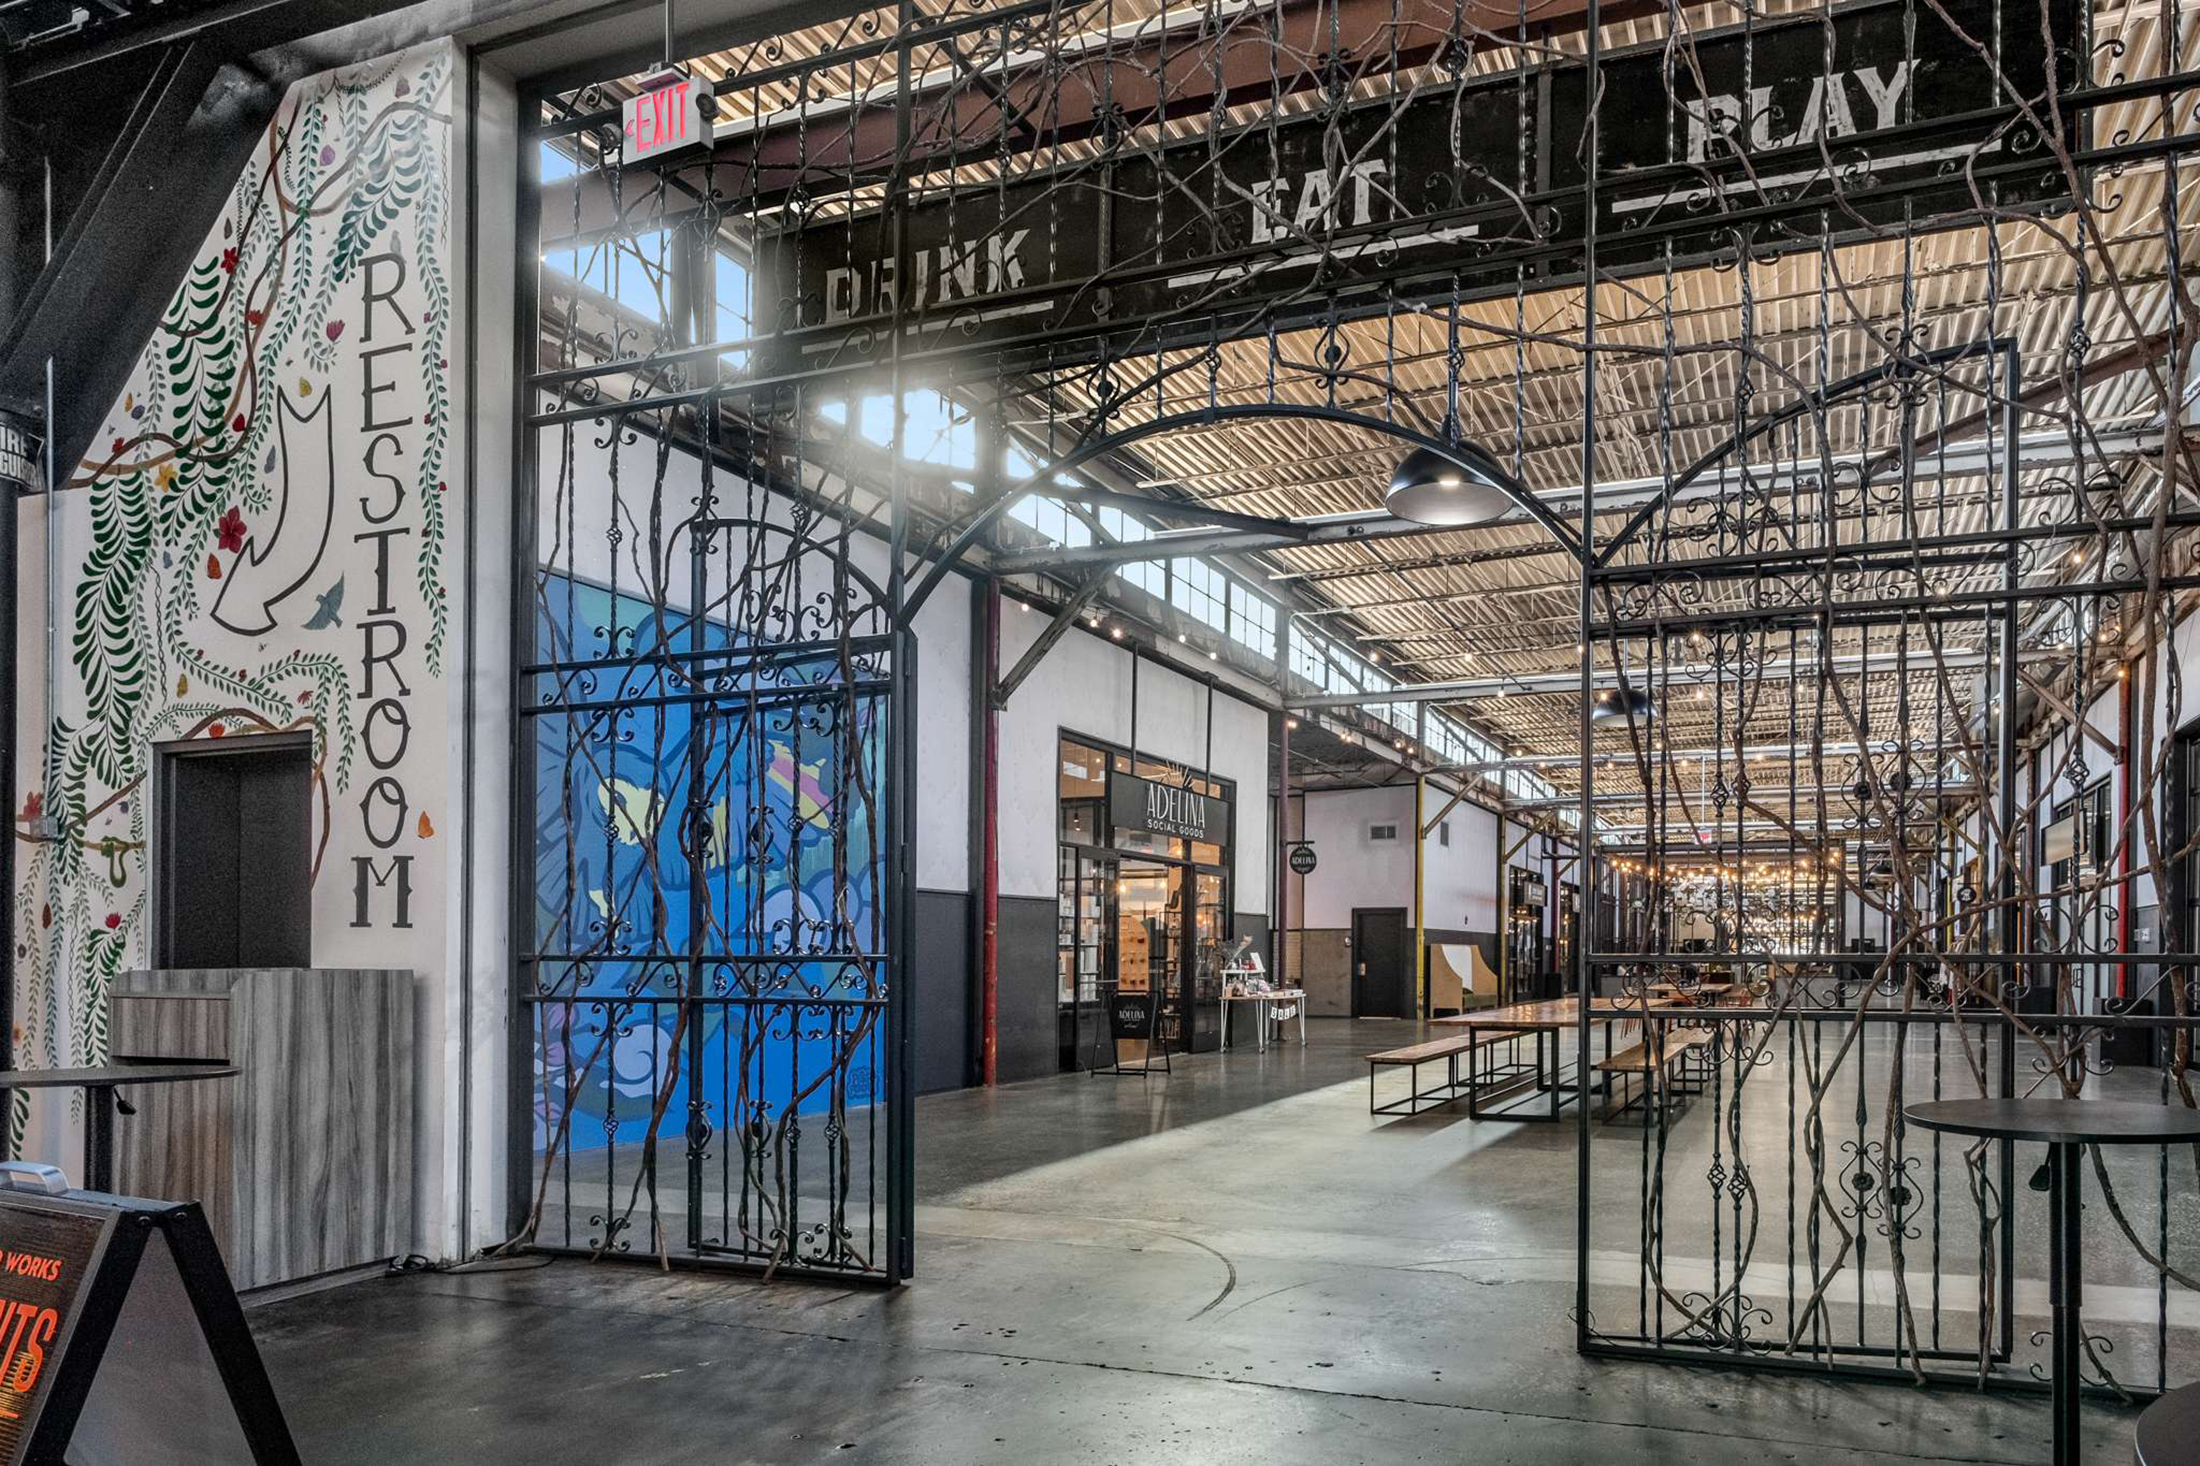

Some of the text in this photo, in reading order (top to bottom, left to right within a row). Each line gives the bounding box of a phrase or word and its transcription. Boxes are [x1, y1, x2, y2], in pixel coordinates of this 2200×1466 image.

[636, 82, 688, 153] EXIT
[1686, 59, 1921, 164] PLAY
[1251, 159, 1388, 244] EAT
[826, 228, 1030, 324] DRINK
[349, 252, 416, 929] RESTROOM
[1147, 783, 1205, 829] ADELINA
[1147, 819, 1204, 839] SOCIAL GOODS
[6, 1251, 62, 1282] WORKS
